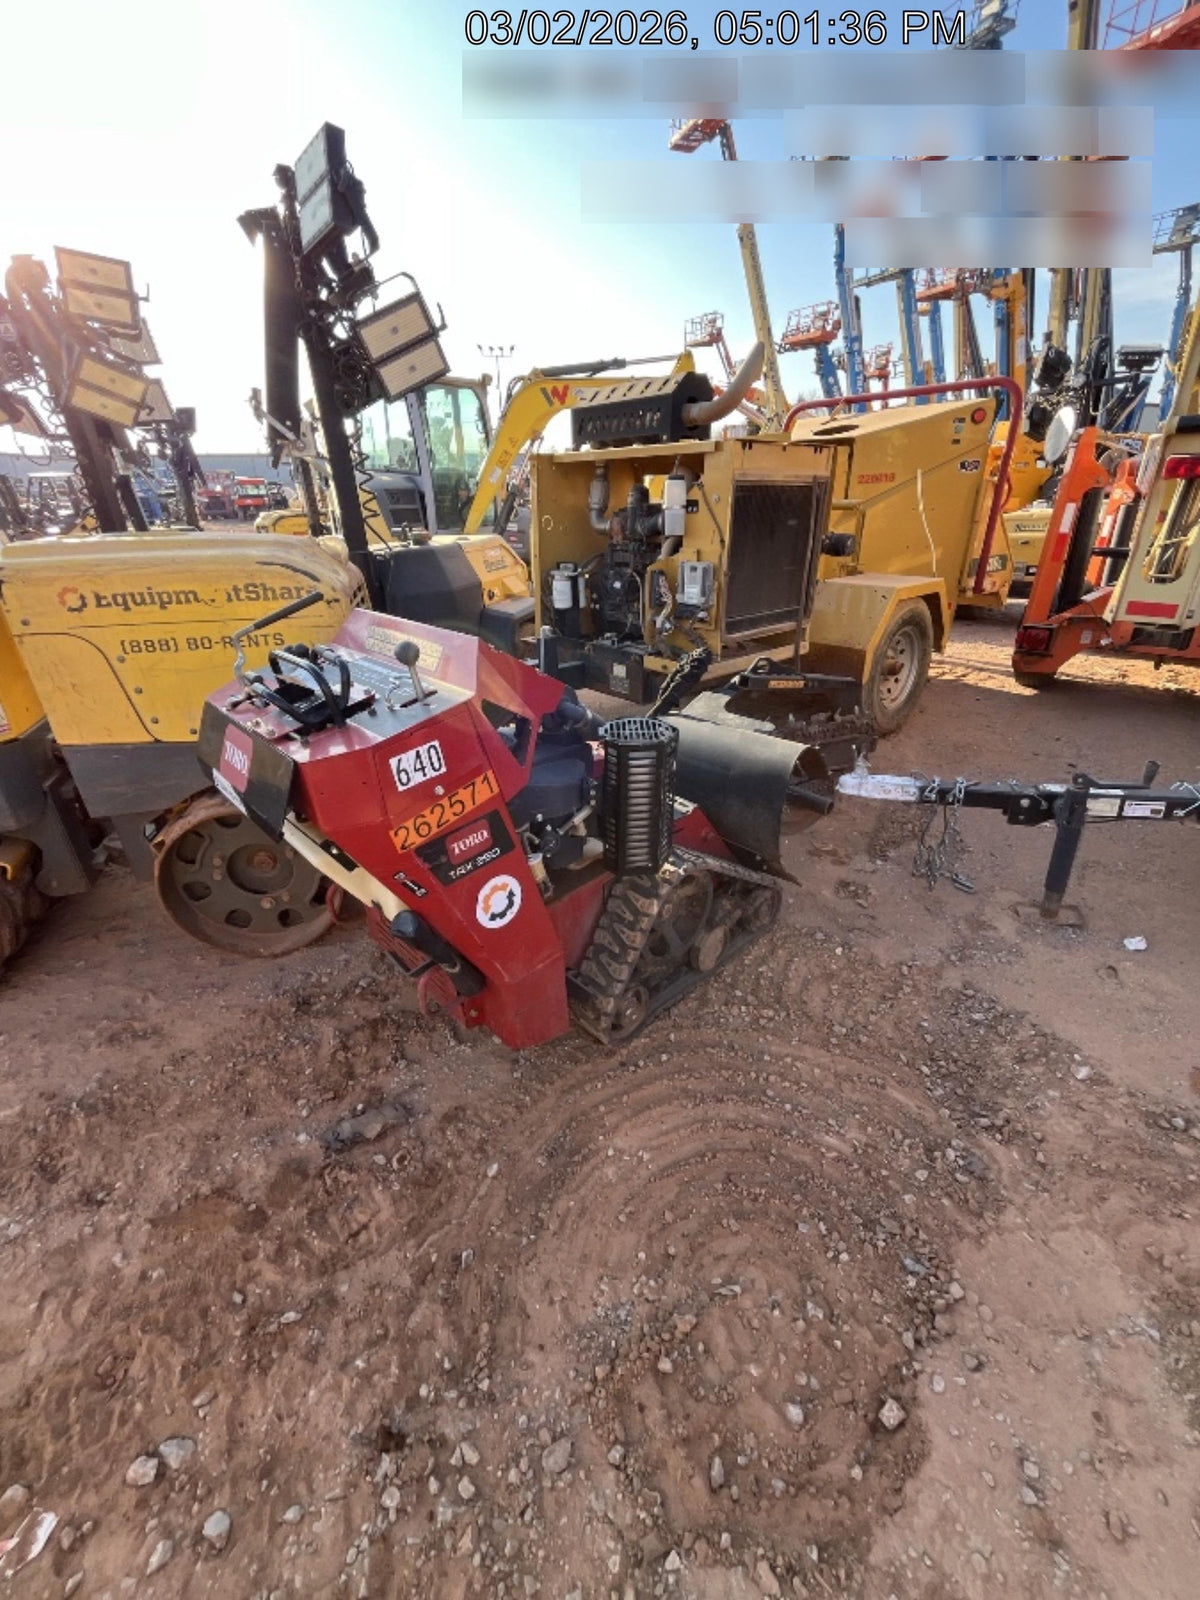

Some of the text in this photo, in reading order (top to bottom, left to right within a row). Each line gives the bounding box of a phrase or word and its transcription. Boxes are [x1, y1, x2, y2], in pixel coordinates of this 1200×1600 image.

[93, 582, 317, 612] EquipmtShar
[120, 637, 179, 655] (888)
[396, 744, 443, 787] 640
[394, 772, 495, 851] 262571
[450, 829, 490, 856] TORO
